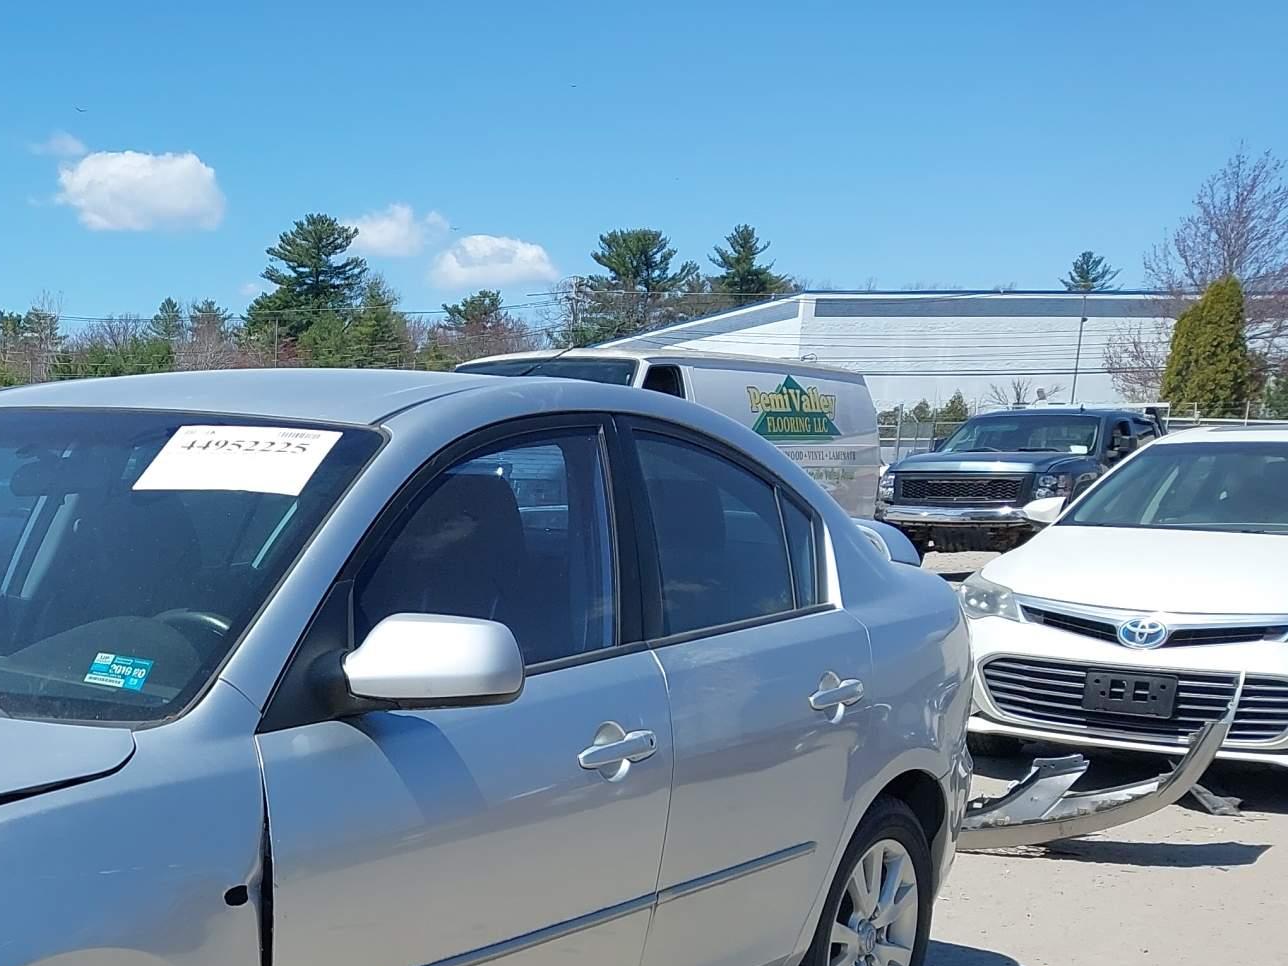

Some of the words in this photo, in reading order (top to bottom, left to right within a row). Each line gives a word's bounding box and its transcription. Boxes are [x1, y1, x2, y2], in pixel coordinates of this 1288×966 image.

[767, 416, 811, 432] FLOORING
[814, 416, 828, 432] LLC
[181, 439, 310, 453] 44952225
[807, 451, 825, 461] VINYL
[828, 451, 856, 461] LAMINATE
